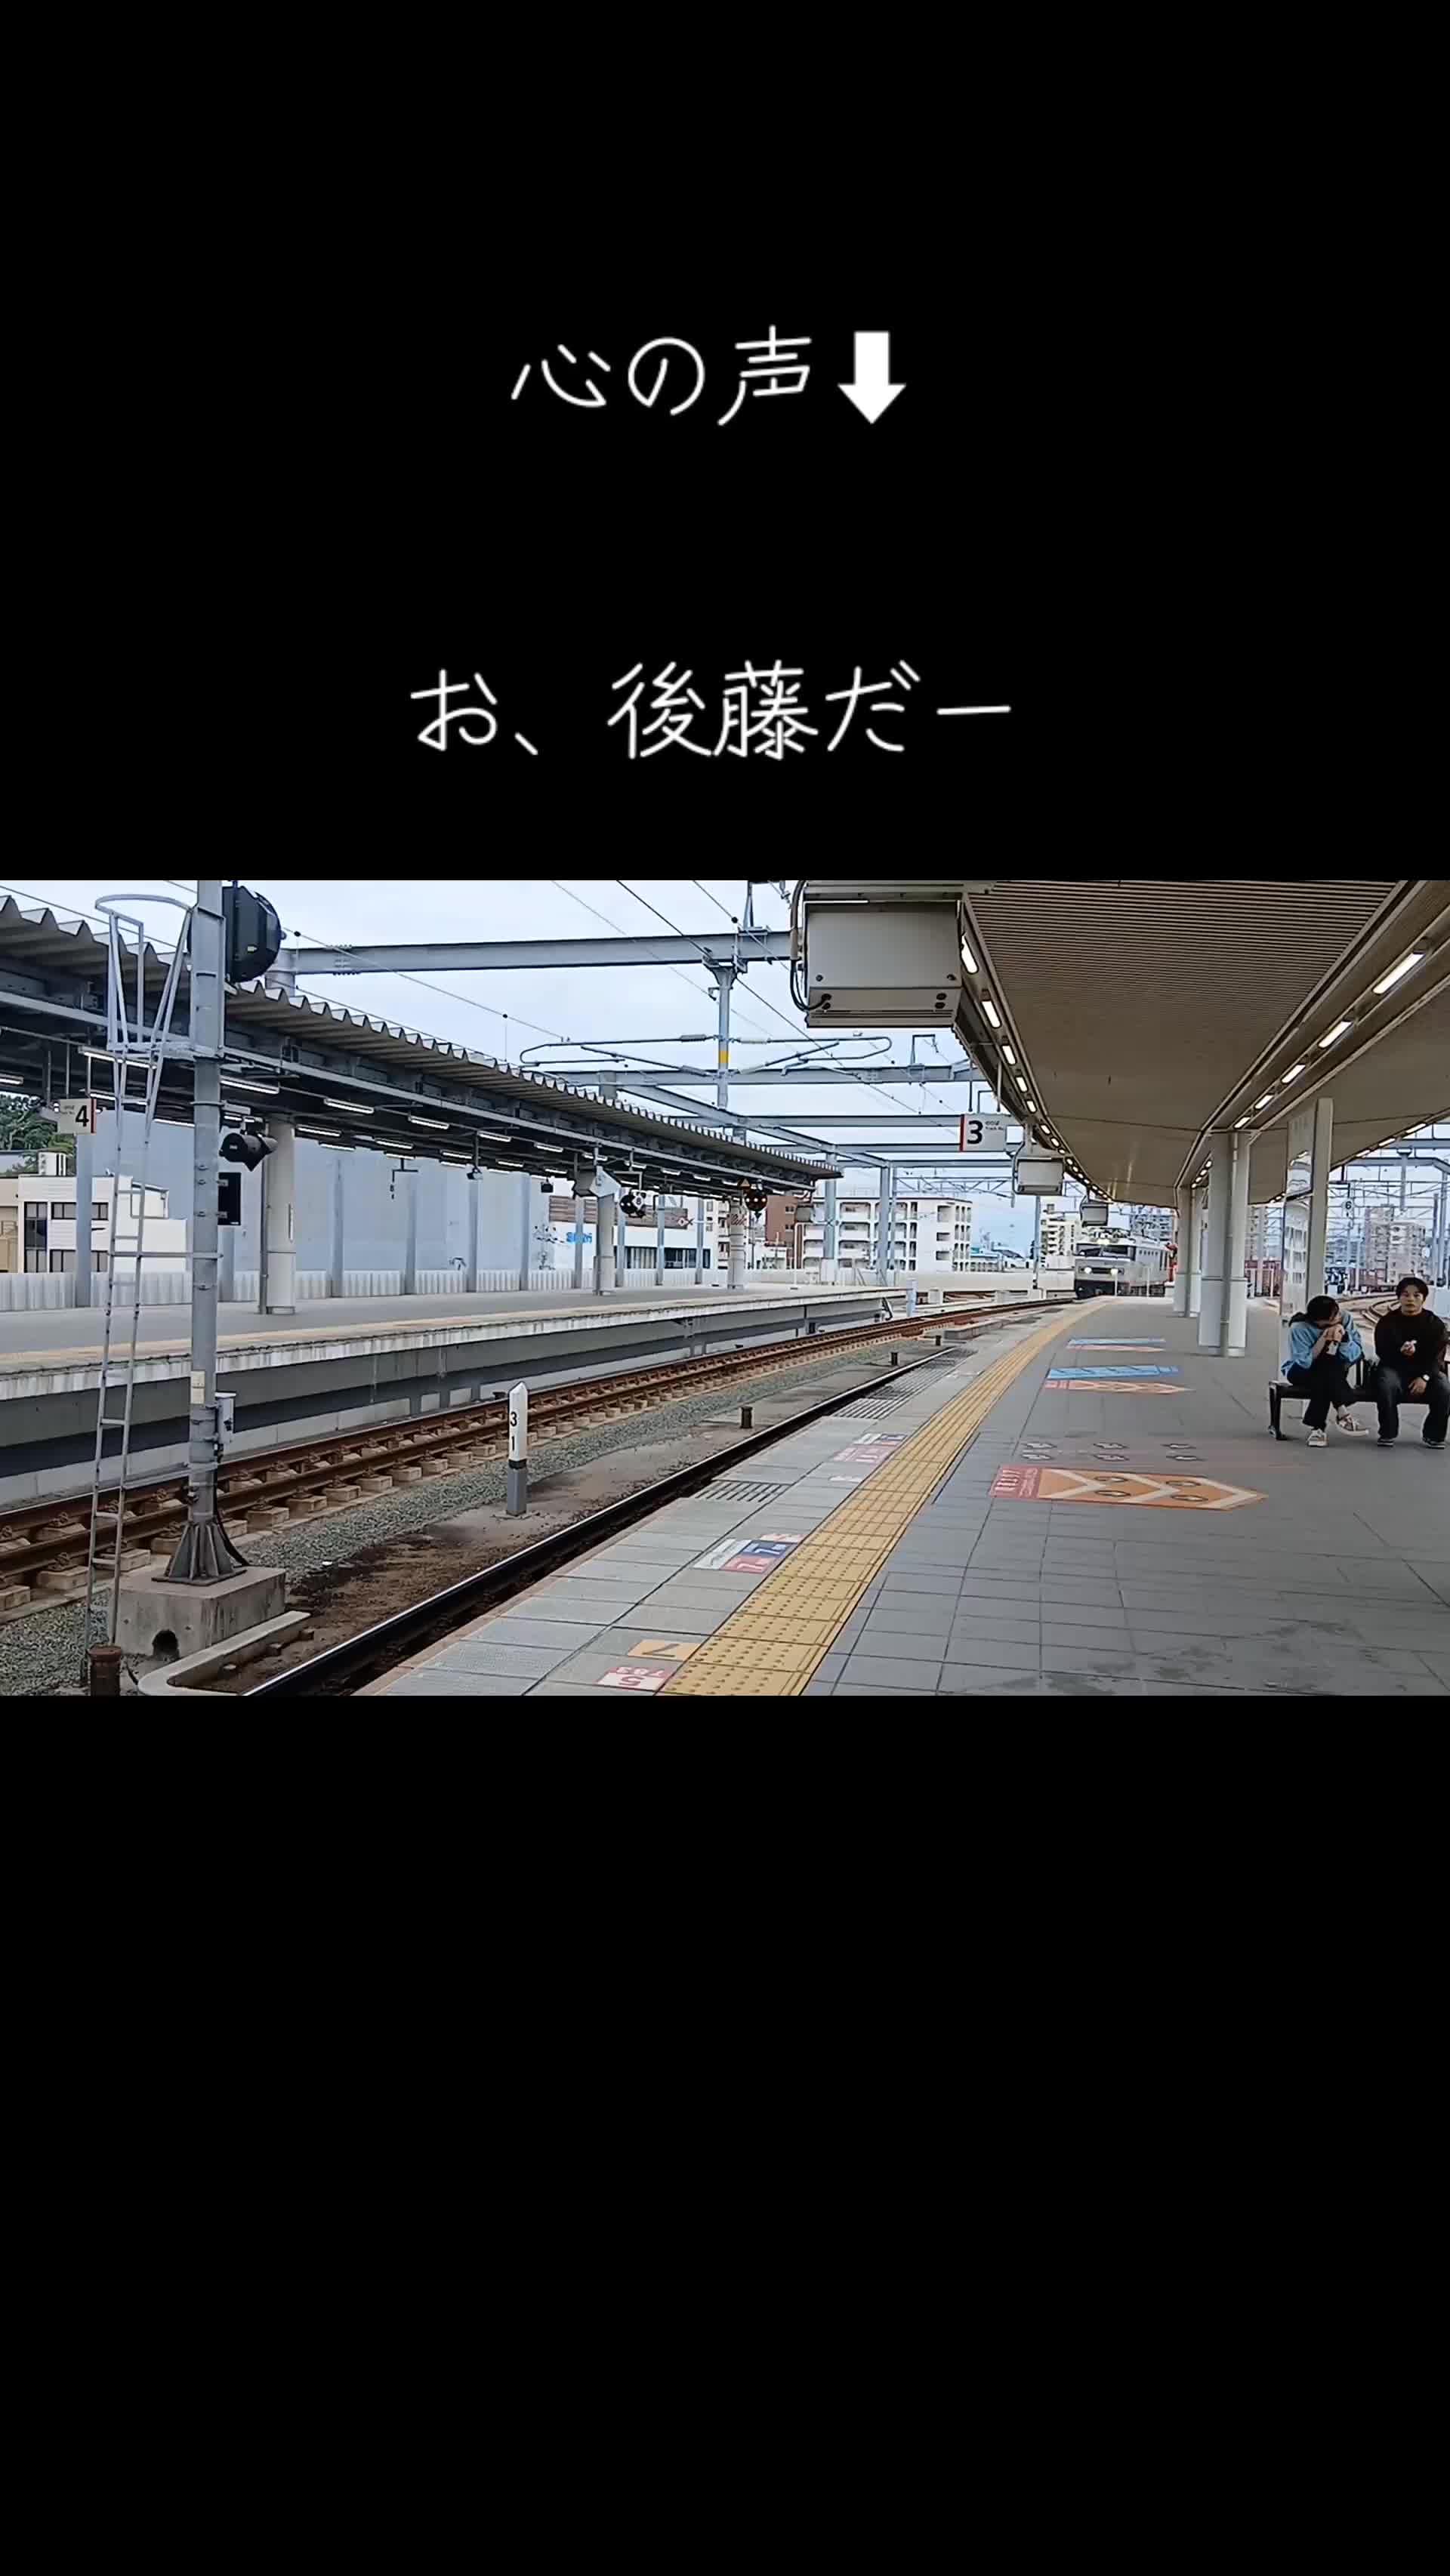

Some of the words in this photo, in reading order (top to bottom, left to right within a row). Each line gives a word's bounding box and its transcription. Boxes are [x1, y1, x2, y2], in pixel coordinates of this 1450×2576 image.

[76, 1105, 89, 1127] 4
[967, 1120, 983, 1144] 3
[511, 1410, 517, 1427] 3
[511, 1435, 515, 1451] 1
